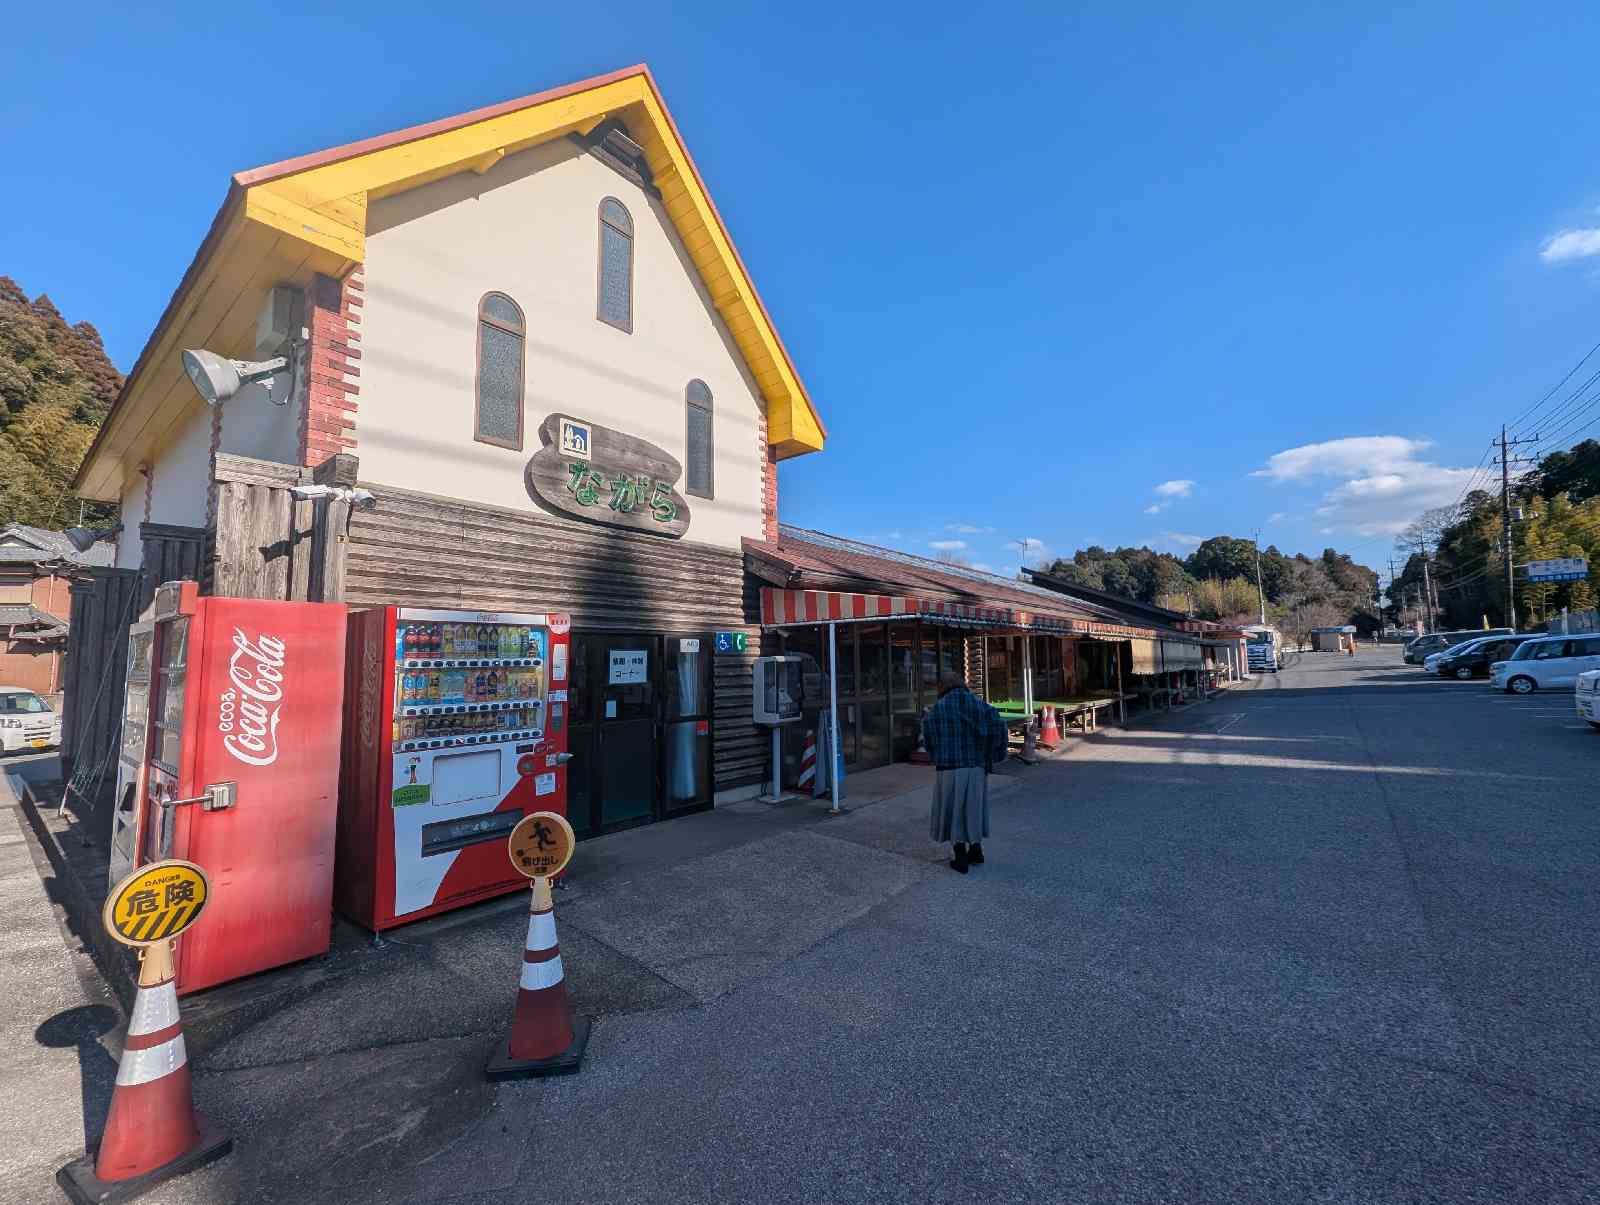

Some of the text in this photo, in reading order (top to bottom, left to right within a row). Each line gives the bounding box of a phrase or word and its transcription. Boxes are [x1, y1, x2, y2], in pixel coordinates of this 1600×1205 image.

[566, 461, 679, 523] ながら
[223, 625, 285, 766] Coca-Cola
[126, 880, 197, 918] 危険
